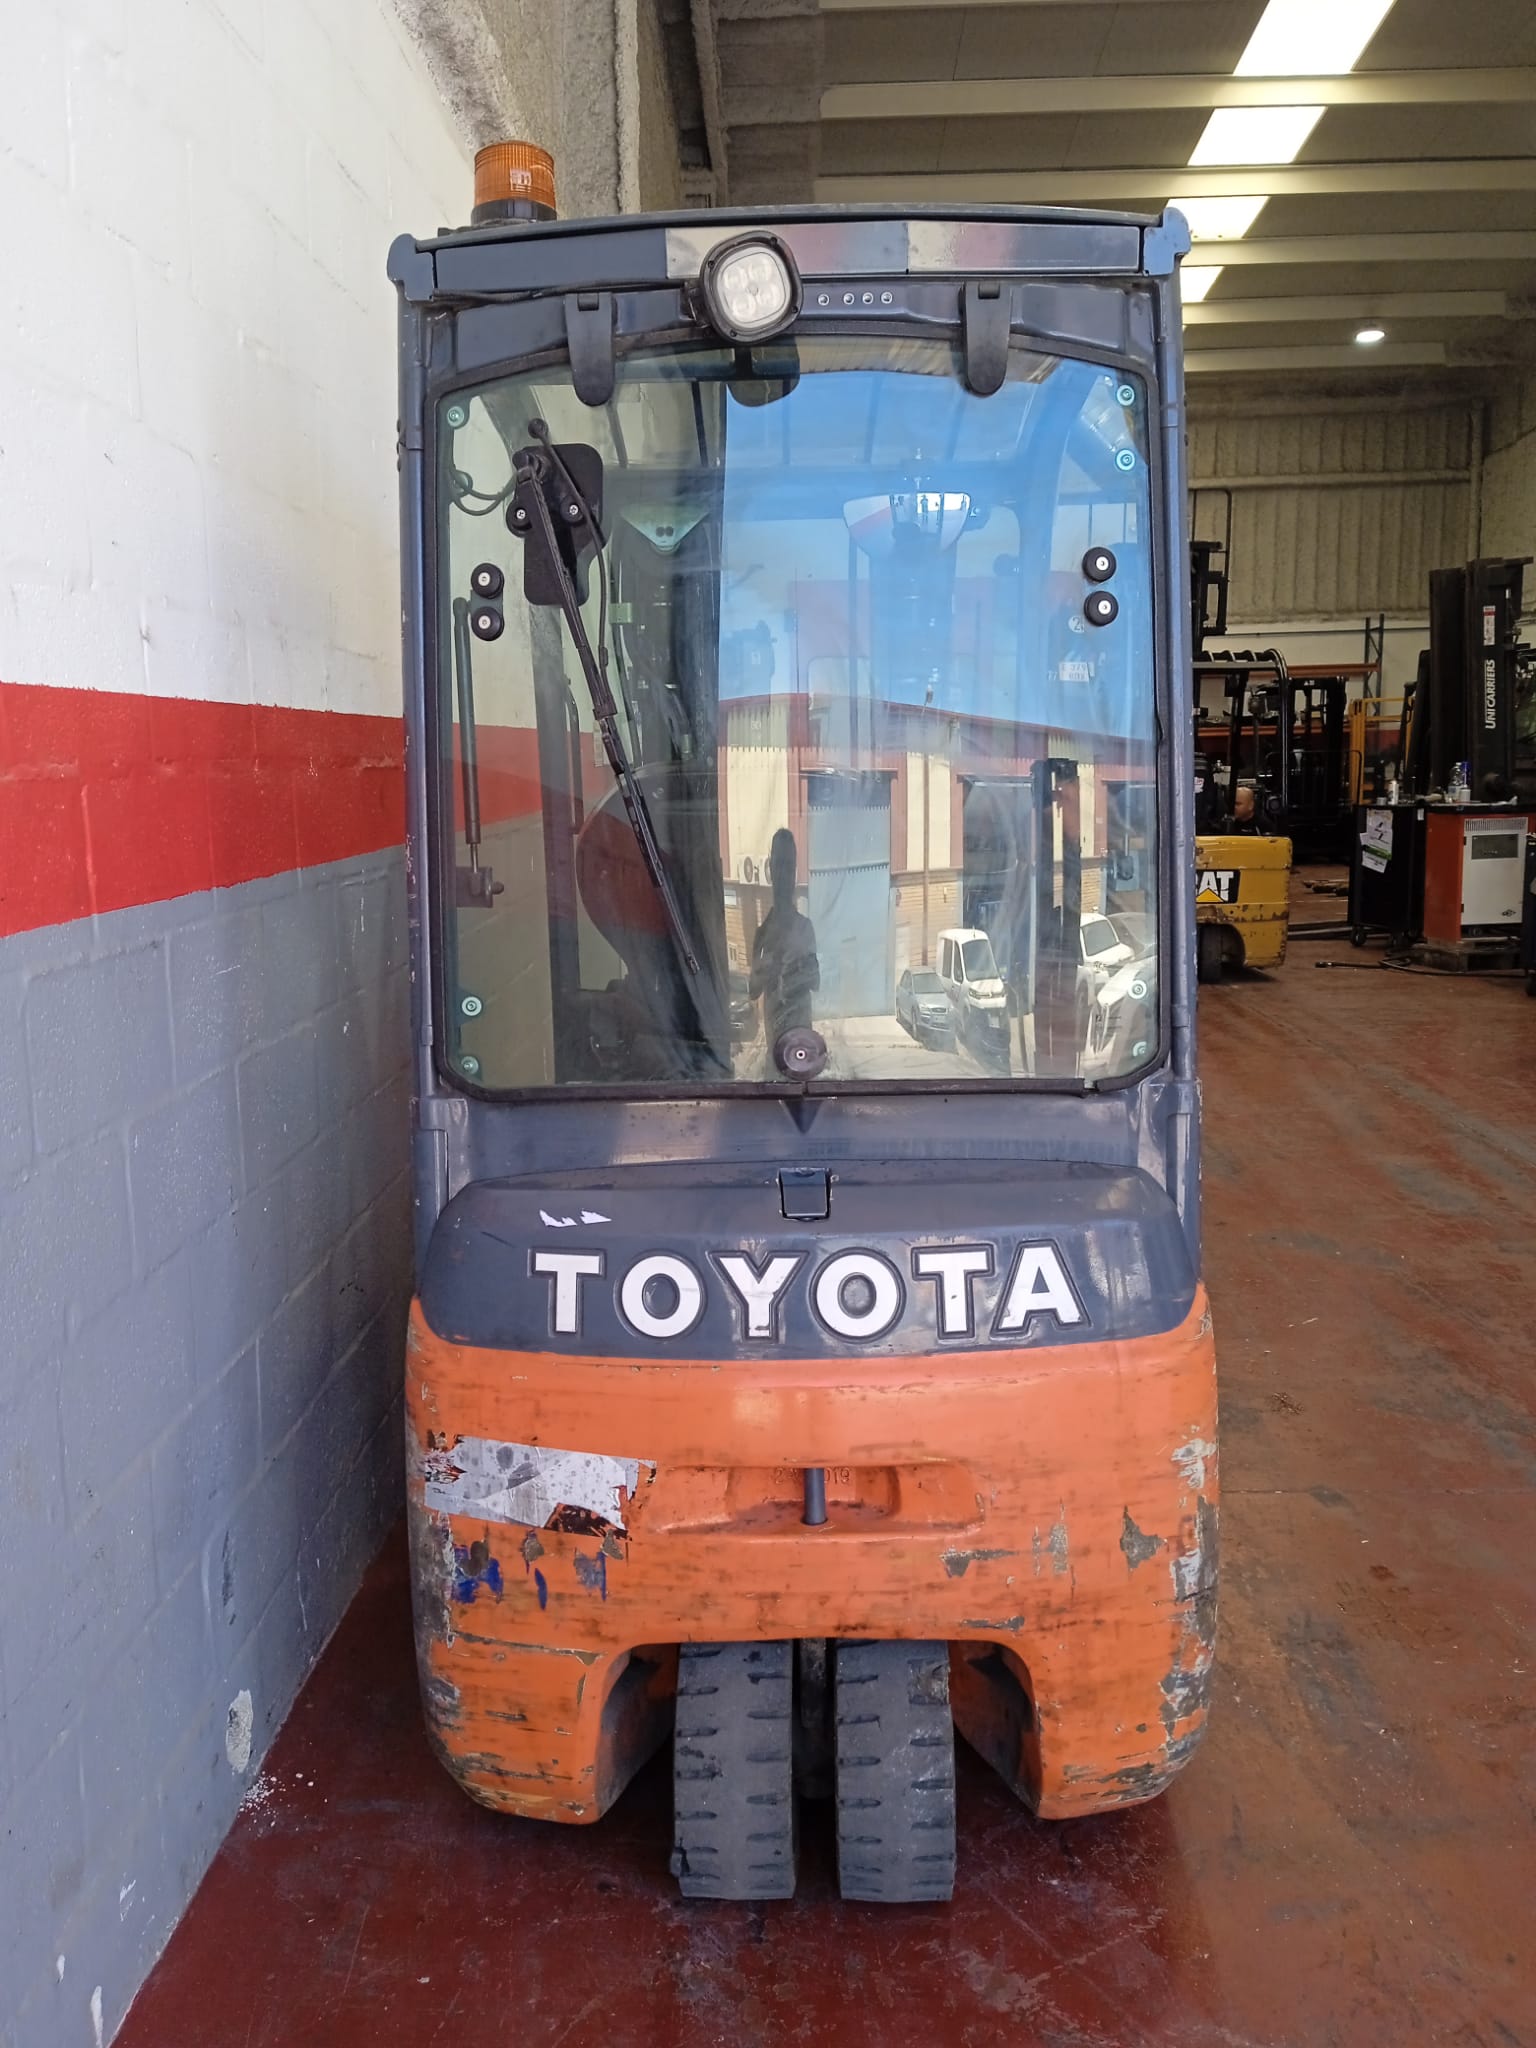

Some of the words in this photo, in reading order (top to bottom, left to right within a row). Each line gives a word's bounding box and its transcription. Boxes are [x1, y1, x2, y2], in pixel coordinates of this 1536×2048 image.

[1484, 659, 1496, 729] UNICARRIERS
[1195, 870, 1235, 902] AT
[532, 1247, 1083, 1339] TOYOTA
